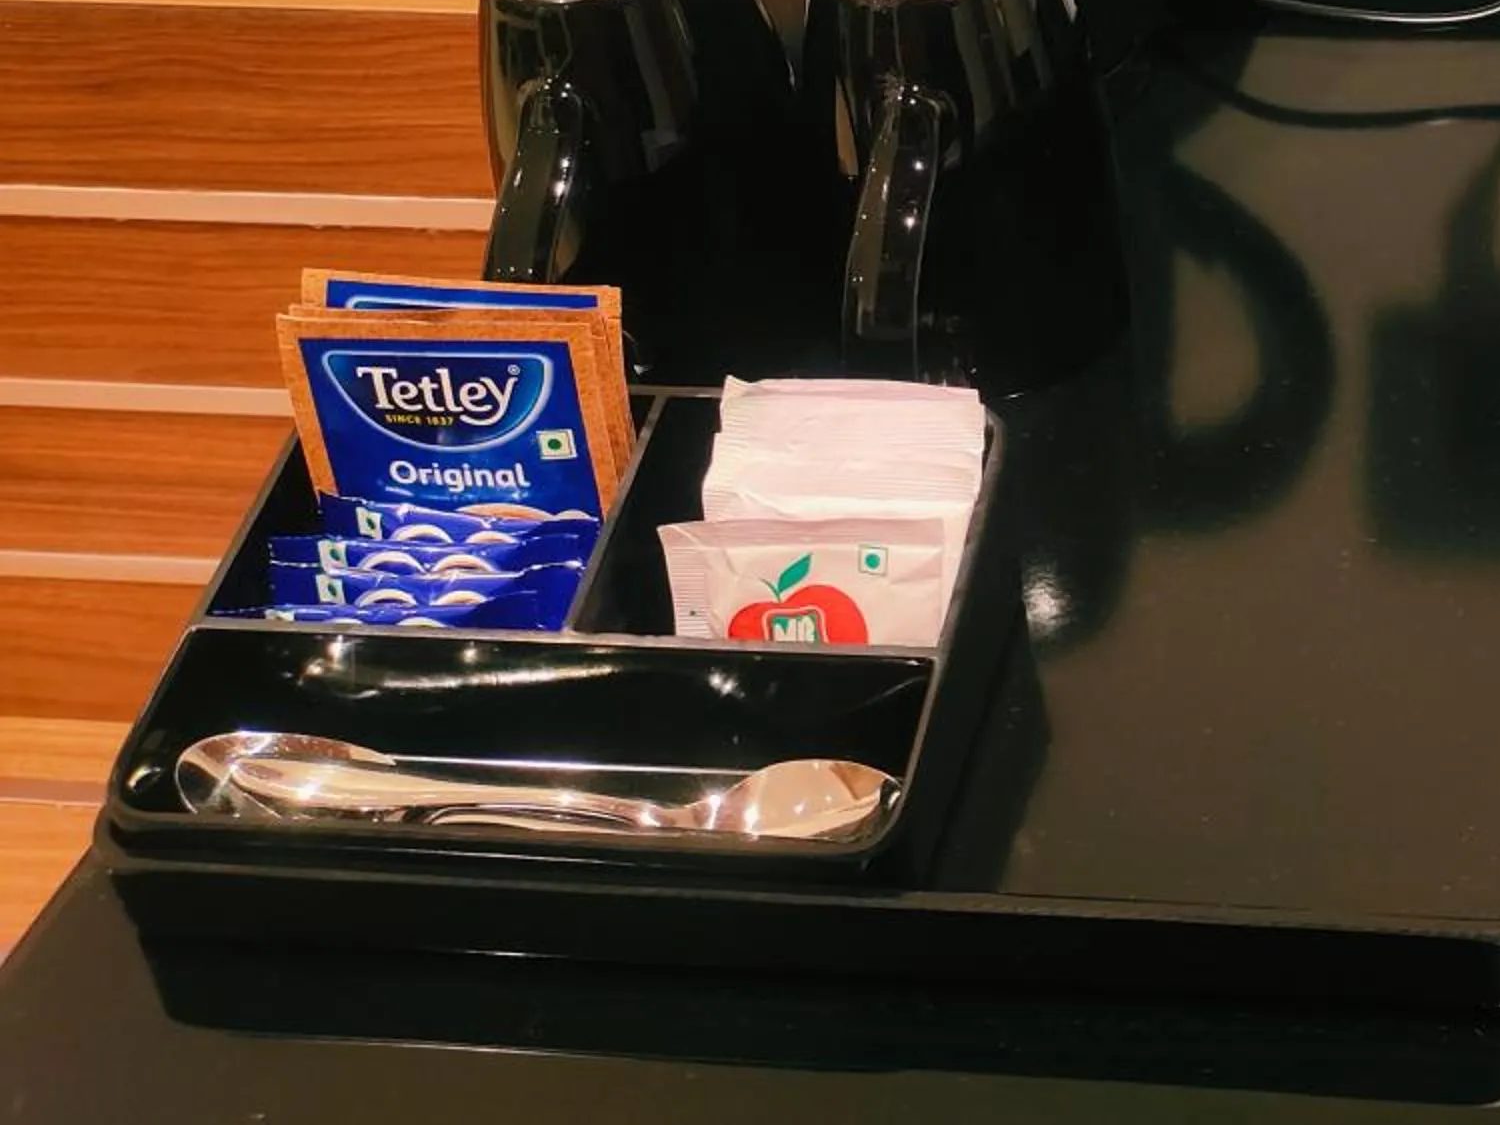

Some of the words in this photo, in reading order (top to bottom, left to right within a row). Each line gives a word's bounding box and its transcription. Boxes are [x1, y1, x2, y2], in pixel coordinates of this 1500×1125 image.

[356, 366, 518, 425] Tetley
[384, 413, 422, 425] SINCE
[389, 459, 530, 493] Original
